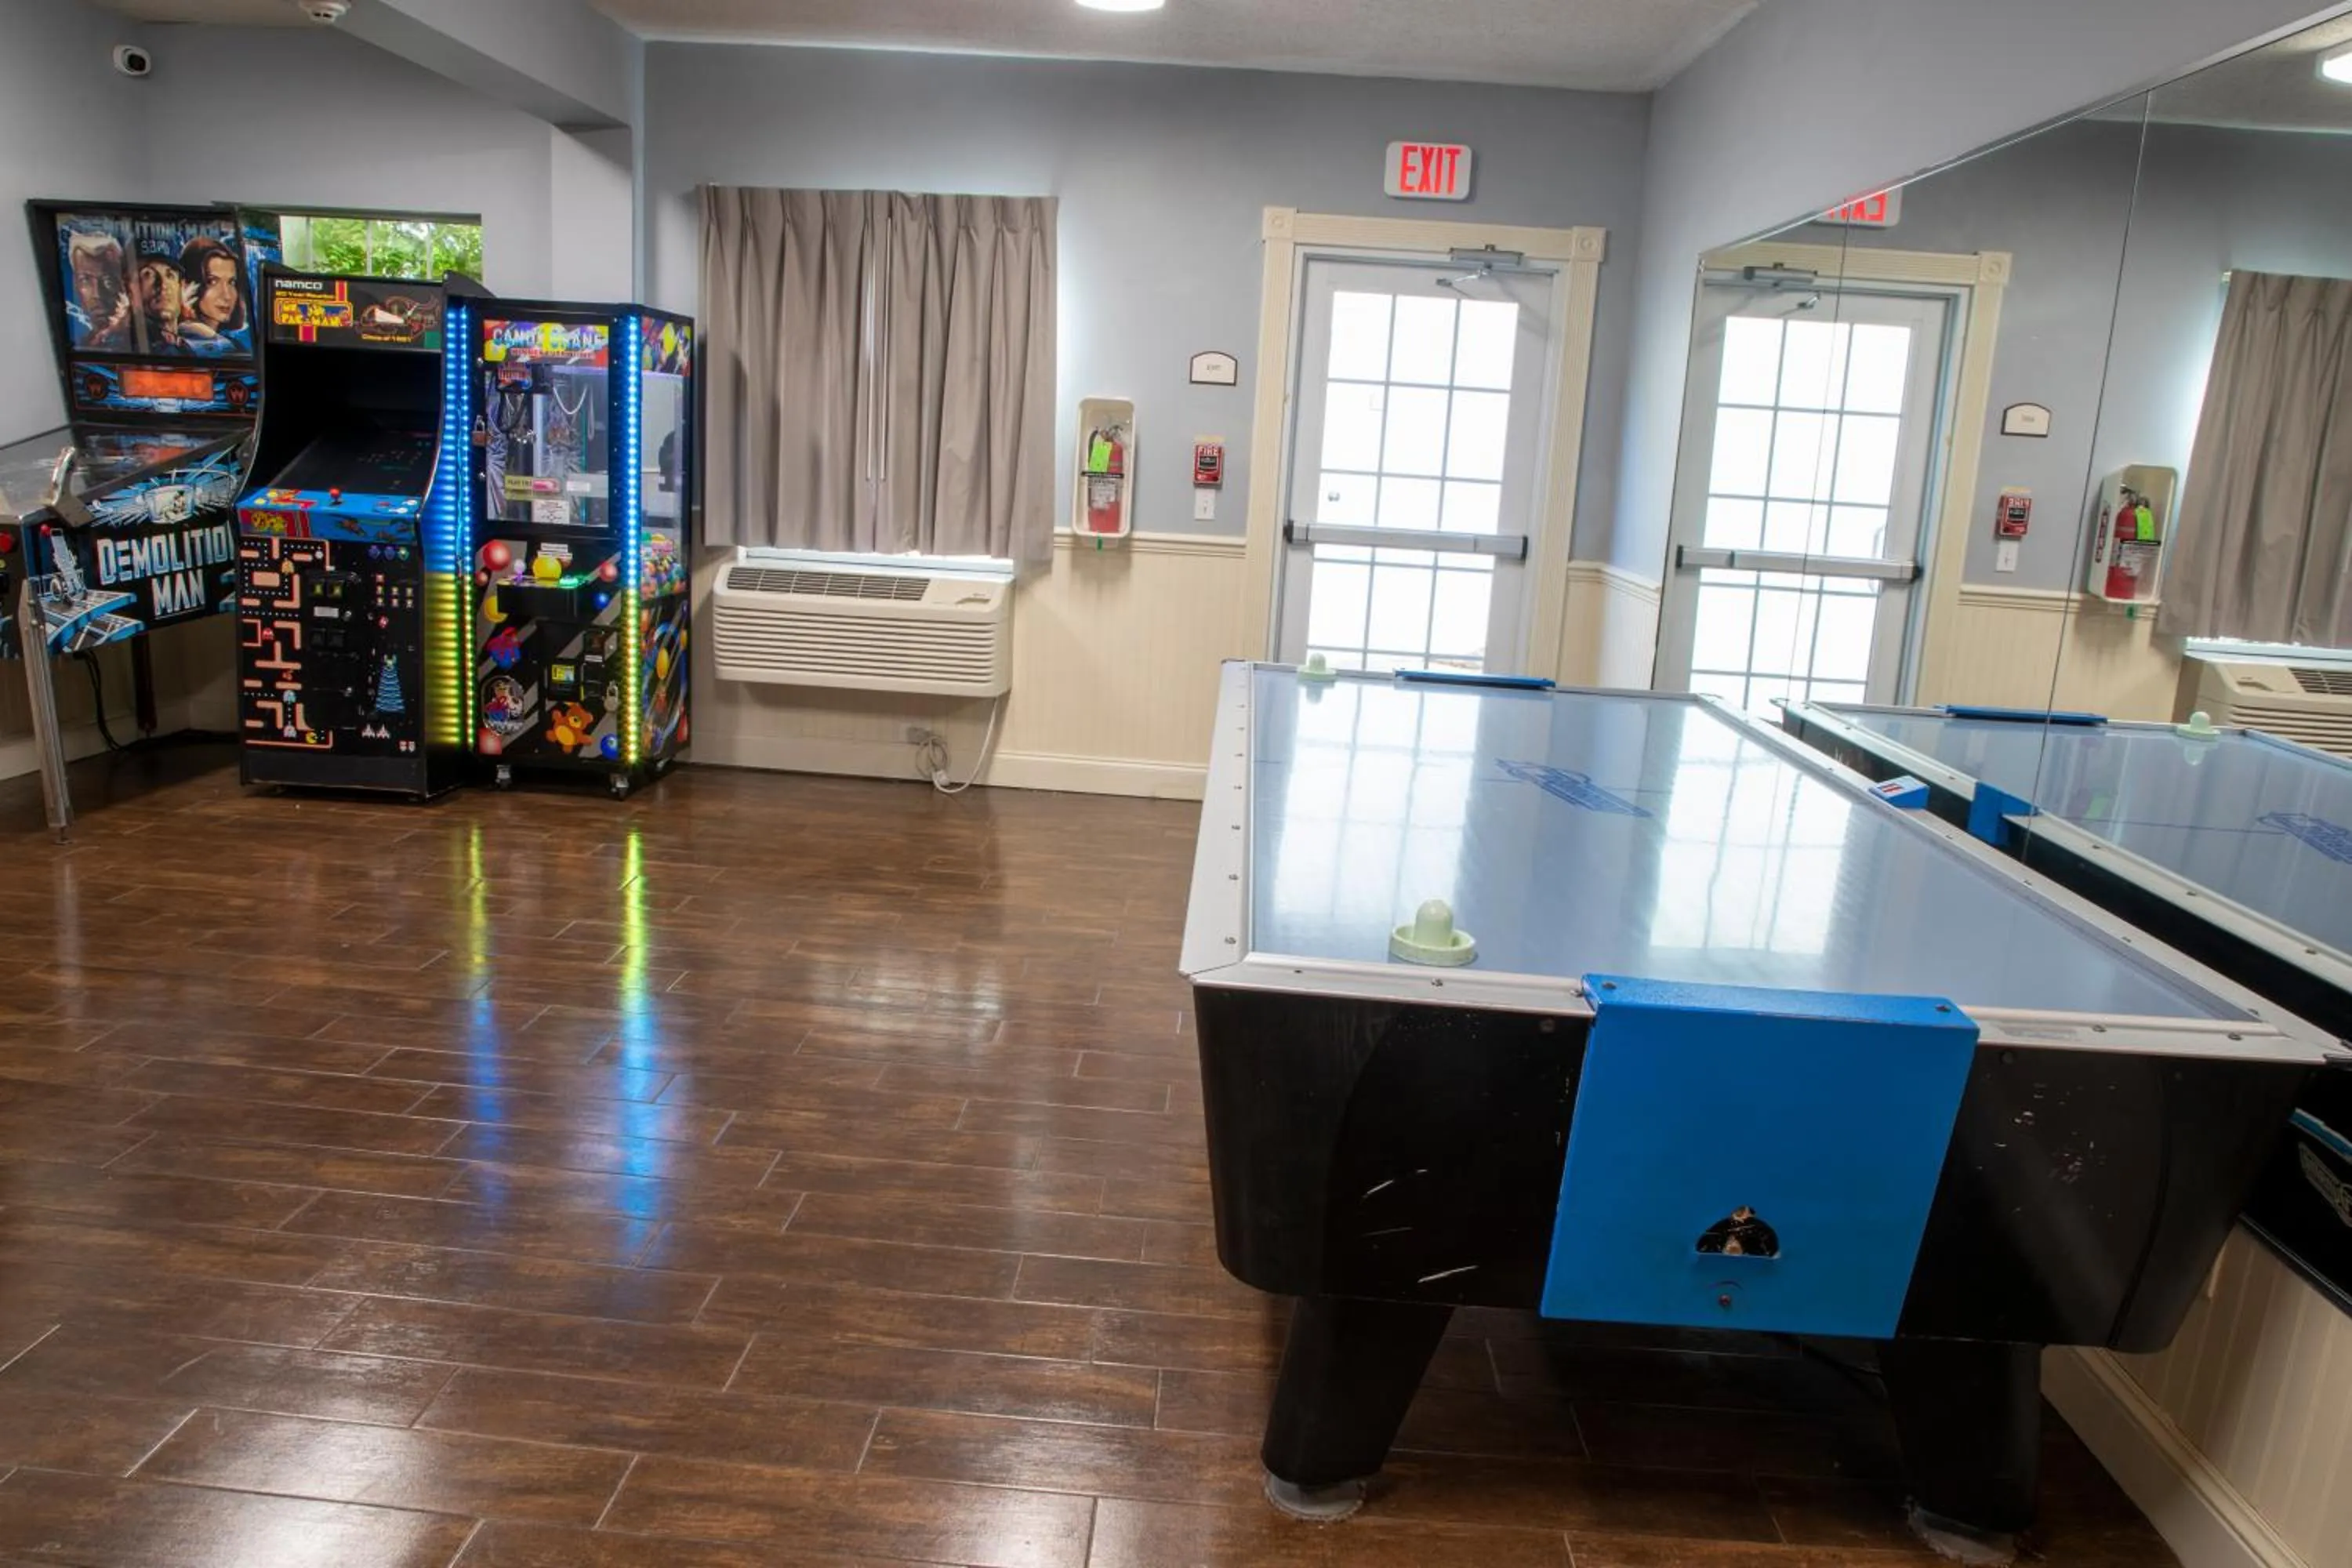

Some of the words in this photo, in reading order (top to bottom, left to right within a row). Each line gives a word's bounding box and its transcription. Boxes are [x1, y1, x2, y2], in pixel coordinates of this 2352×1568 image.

[1400, 144, 1462, 194] EXIT
[274, 278, 323, 291] namco
[492, 327, 543, 351] CANDY
[1197, 446, 1218, 456] FIRE
[151, 568, 205, 617] MAN
